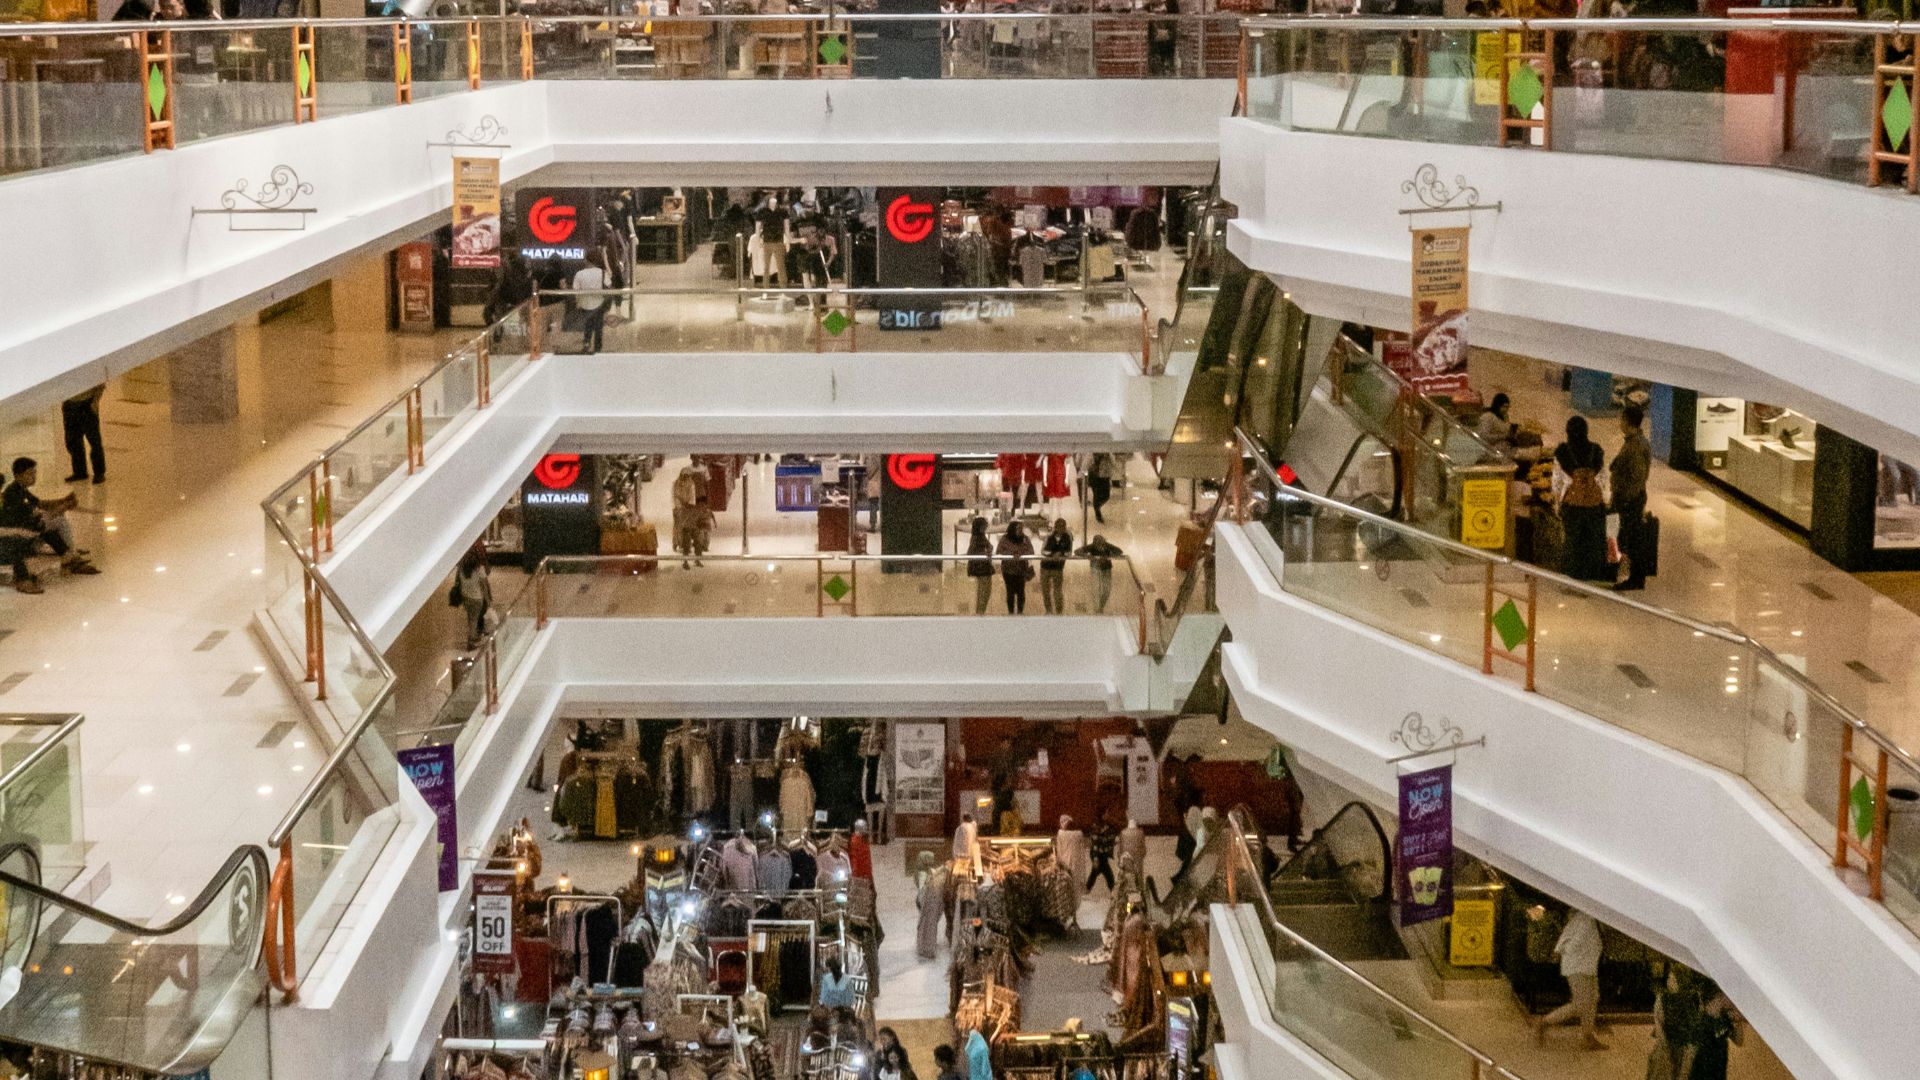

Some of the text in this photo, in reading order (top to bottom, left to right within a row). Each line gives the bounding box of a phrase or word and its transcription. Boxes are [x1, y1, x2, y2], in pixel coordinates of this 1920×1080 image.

[527, 493, 589, 504] MATAHARI
[413, 775, 445, 790] pen
[1408, 784, 1443, 801] NOW
[1408, 799, 1443, 821] Open
[482, 916, 505, 939] 50
[481, 940, 505, 952] OFF
